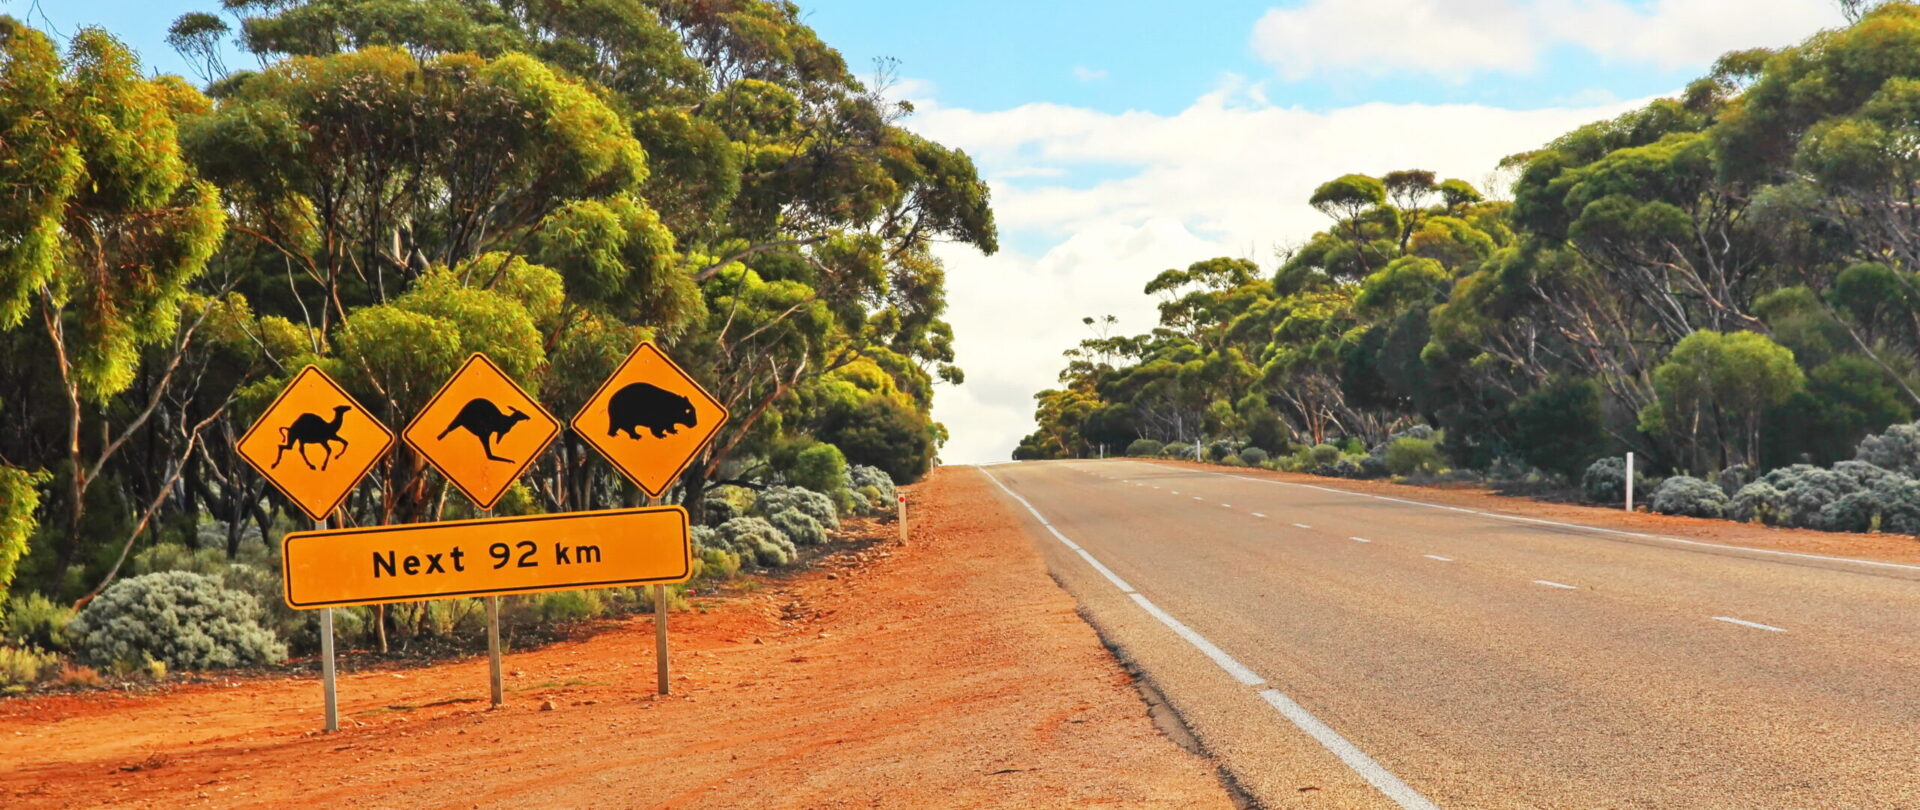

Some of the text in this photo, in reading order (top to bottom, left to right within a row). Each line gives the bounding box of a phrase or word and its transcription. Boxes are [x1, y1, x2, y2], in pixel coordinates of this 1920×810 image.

[372, 540, 602, 578] Next 92 km
